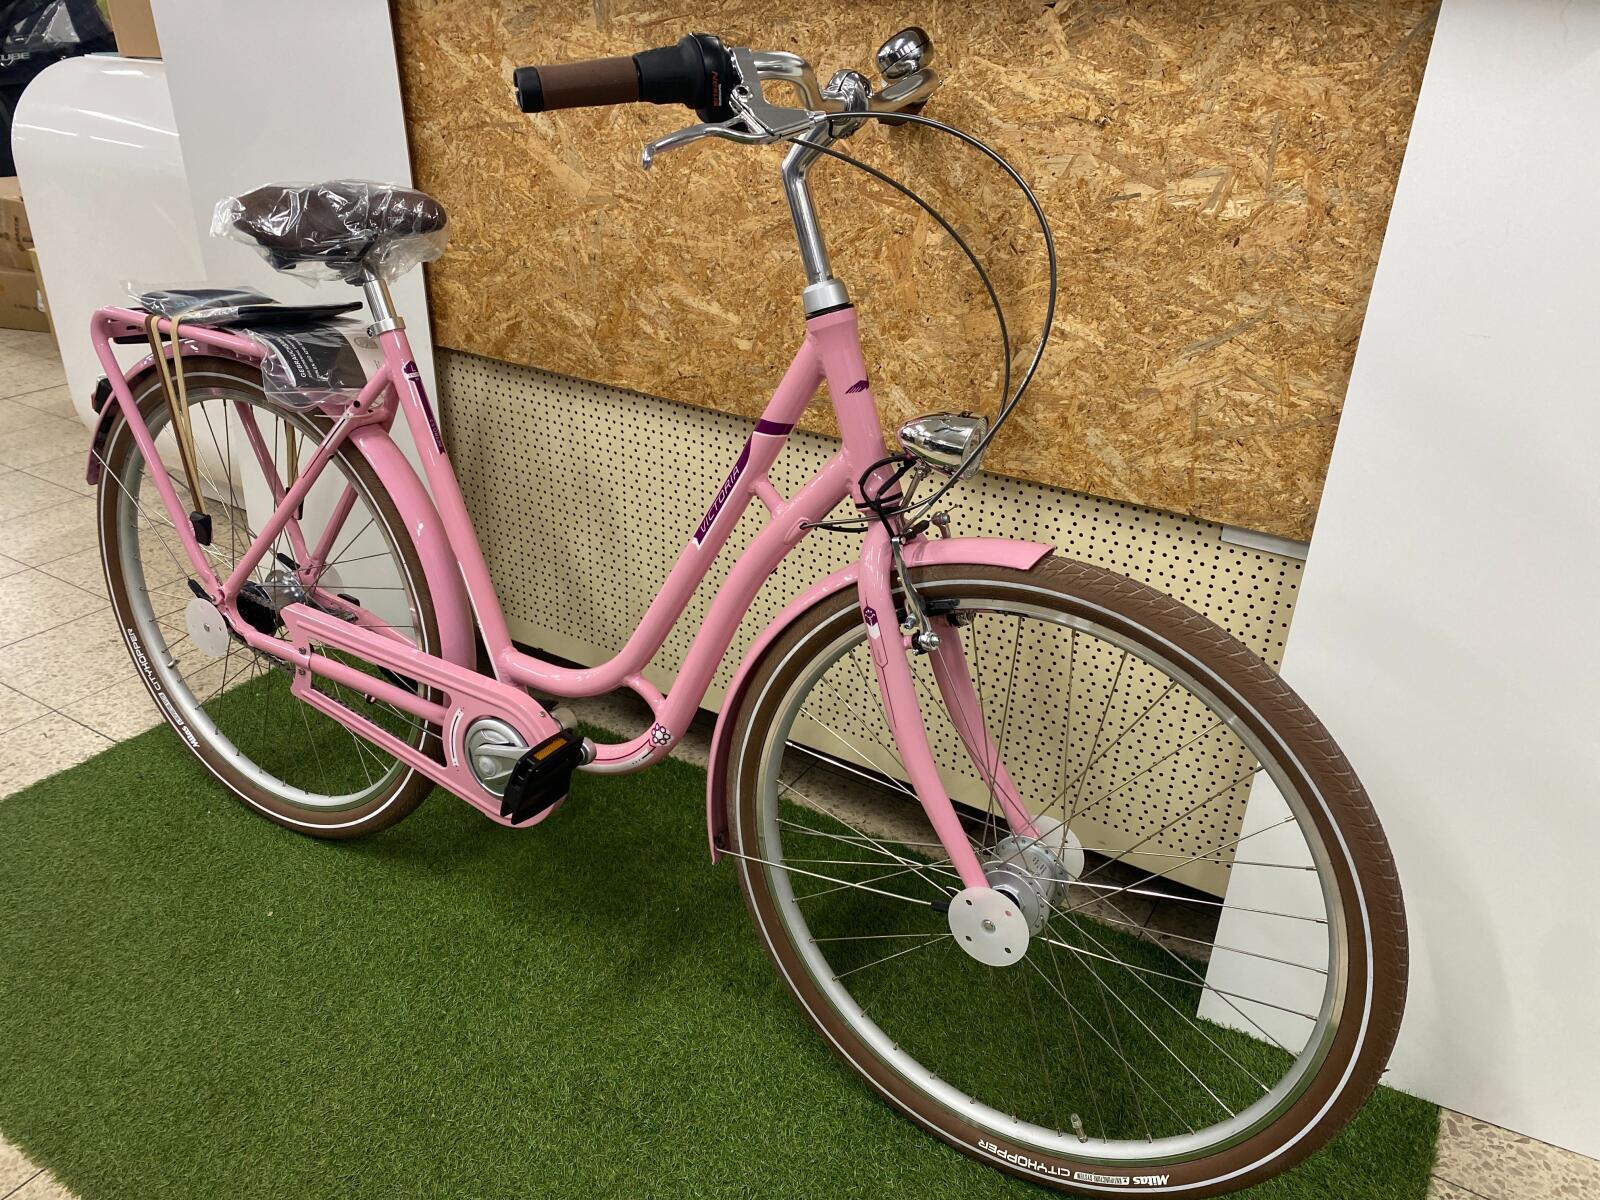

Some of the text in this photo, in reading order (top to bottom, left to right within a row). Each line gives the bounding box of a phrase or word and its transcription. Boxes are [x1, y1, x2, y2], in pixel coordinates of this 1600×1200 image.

[0, 52, 30, 61] UBE
[700, 465, 740, 533] VICTORIA
[127, 628, 200, 748] Mitas CITYHOPPER
[978, 1138, 1071, 1177] CITYHOPPER
[1133, 1174, 1170, 1186] Mitas
